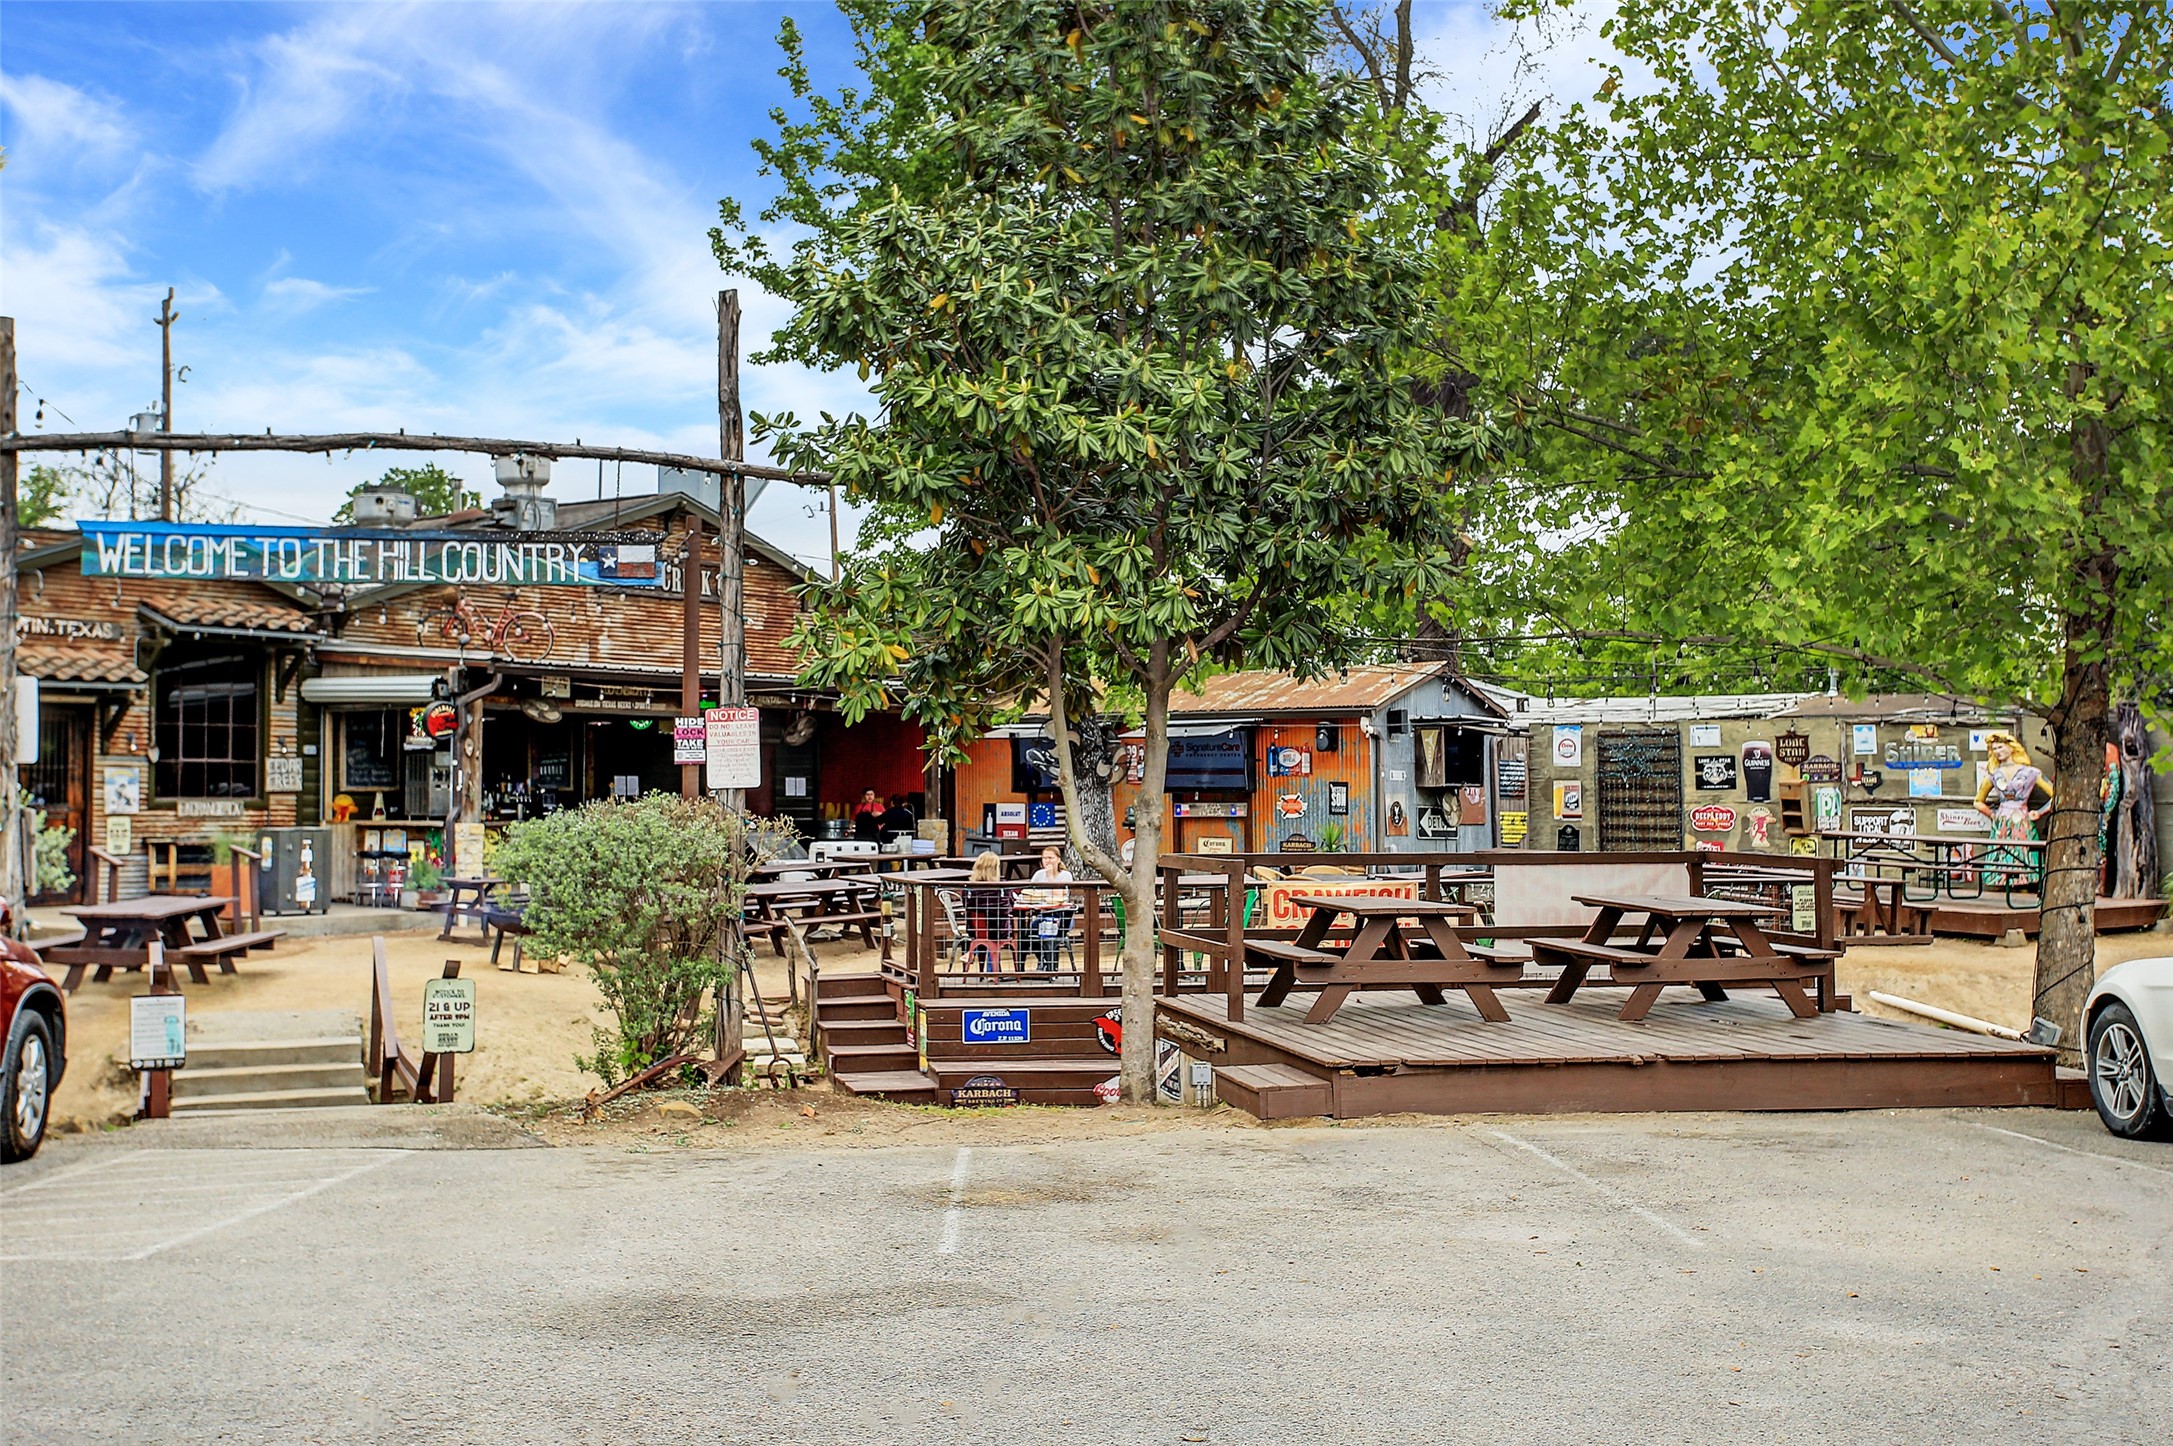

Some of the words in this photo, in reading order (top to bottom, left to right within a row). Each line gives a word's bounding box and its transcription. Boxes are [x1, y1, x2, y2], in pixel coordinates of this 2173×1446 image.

[96, 532, 249, 577] WELCOME
[255, 537, 301, 578] TO
[309, 538, 372, 580] THE
[378, 540, 437, 582] HILL
[441, 540, 585, 583] COUNTRY
[662, 561, 711, 596] CRK
[55, 620, 113, 639] TEXAS
[710, 709, 755, 721] NOTICE
[675, 717, 705, 726] HIDE
[676, 728, 704, 736] LOCK
[709, 730, 747, 738] VALUABLES
[676, 739, 704, 748] TAKE
[1779, 738, 1805, 747] LONE
[1186, 742, 1240, 754] SignatureCare
[1779, 747, 1806, 757] STAR
[1744, 759, 1770, 767] GUINNESS
[1331, 793, 1346, 806] SON
[1425, 814, 1440, 824] DETO
[1695, 812, 1711, 820] DEEP
[1715, 812, 1731, 820] EDDY
[1853, 815, 1888, 827] SUPPORT
[1940, 812, 1964, 821] Shiner
[1963, 817, 1981, 826] Beer
[1859, 826, 1884, 834] LOCAL
[429, 1002, 440, 1012] 21
[443, 1002, 450, 1011] &
[454, 1002, 470, 1011] UP
[970, 1018, 1022, 1036] Corona
[1097, 1027, 1115, 1052] BREWING
[958, 1089, 1012, 1098] KARBACH
[1092, 1082, 1121, 1097] Coo
